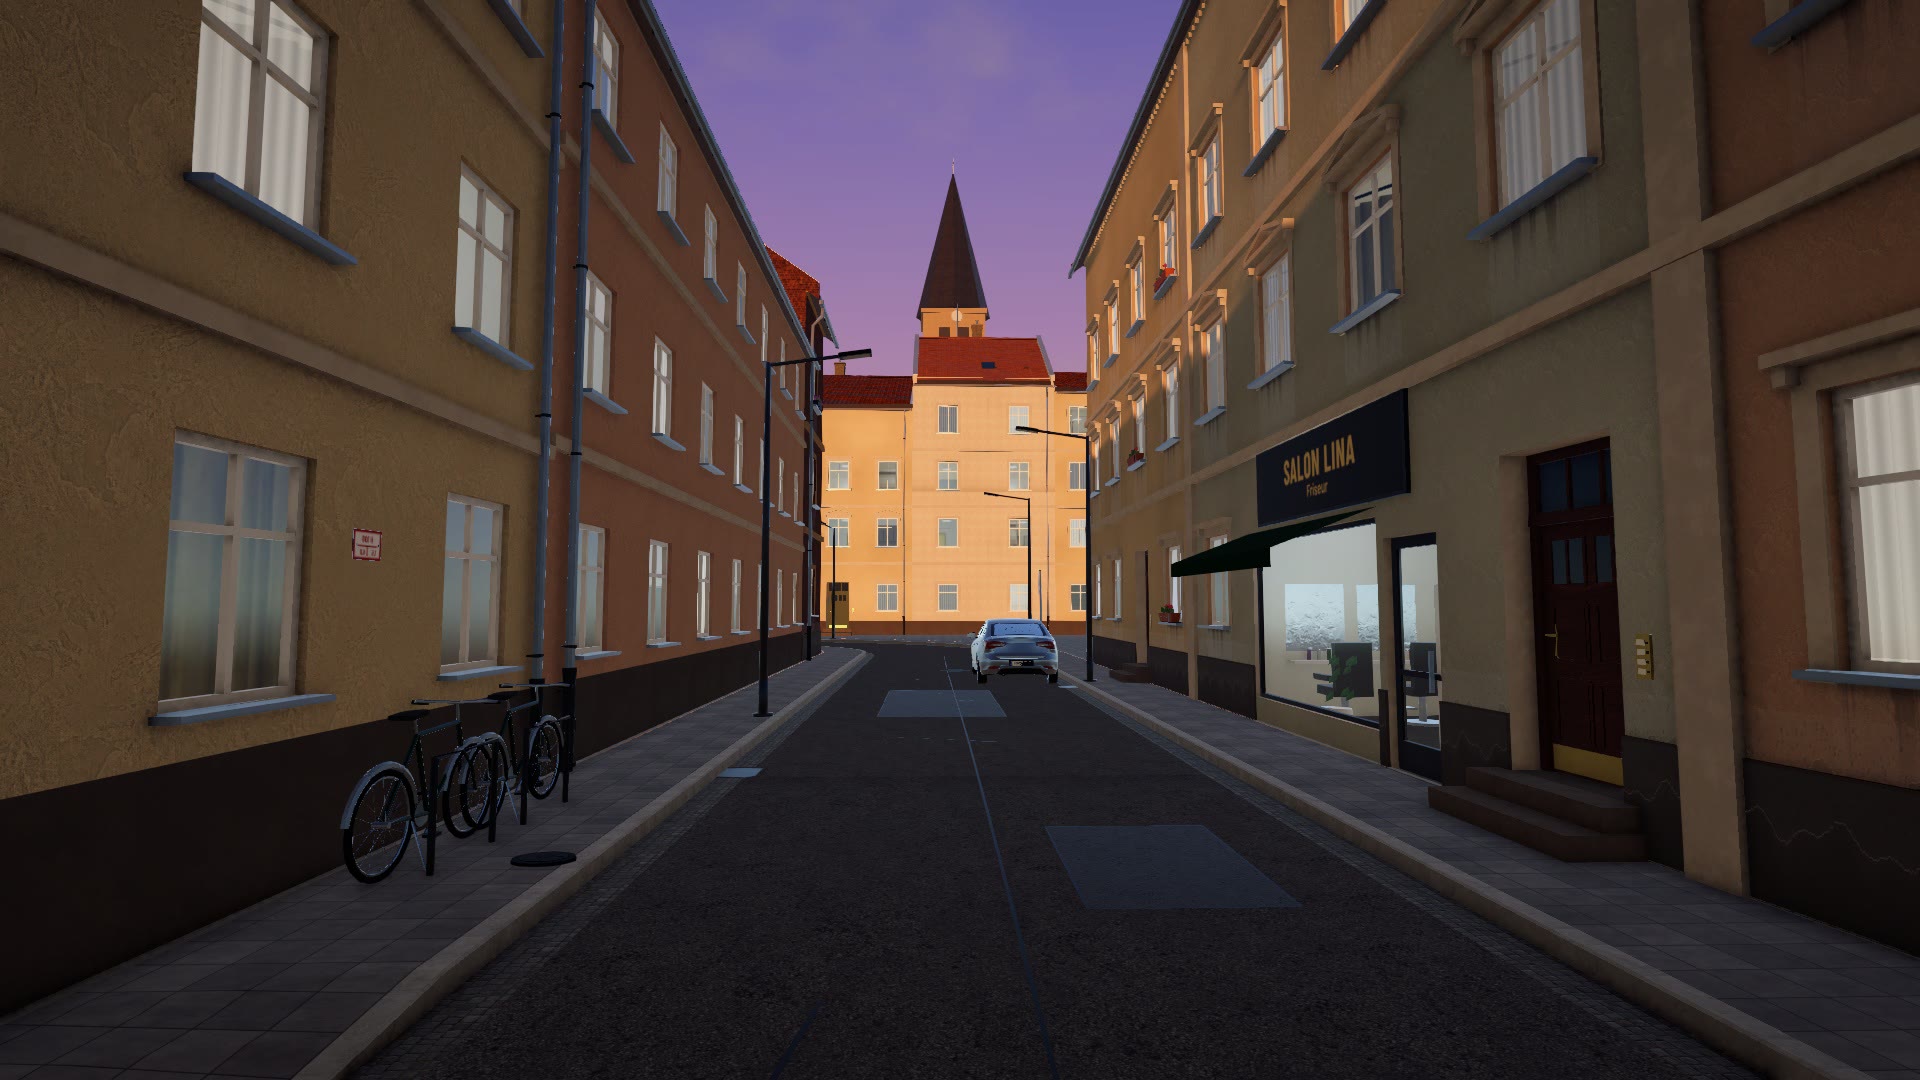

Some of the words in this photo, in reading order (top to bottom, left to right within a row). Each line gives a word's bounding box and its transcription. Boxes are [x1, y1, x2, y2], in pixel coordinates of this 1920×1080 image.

[1283, 448, 1320, 486] SALON
[1323, 434, 1356, 473] LINA
[1306, 481, 1328, 497] Friseur
